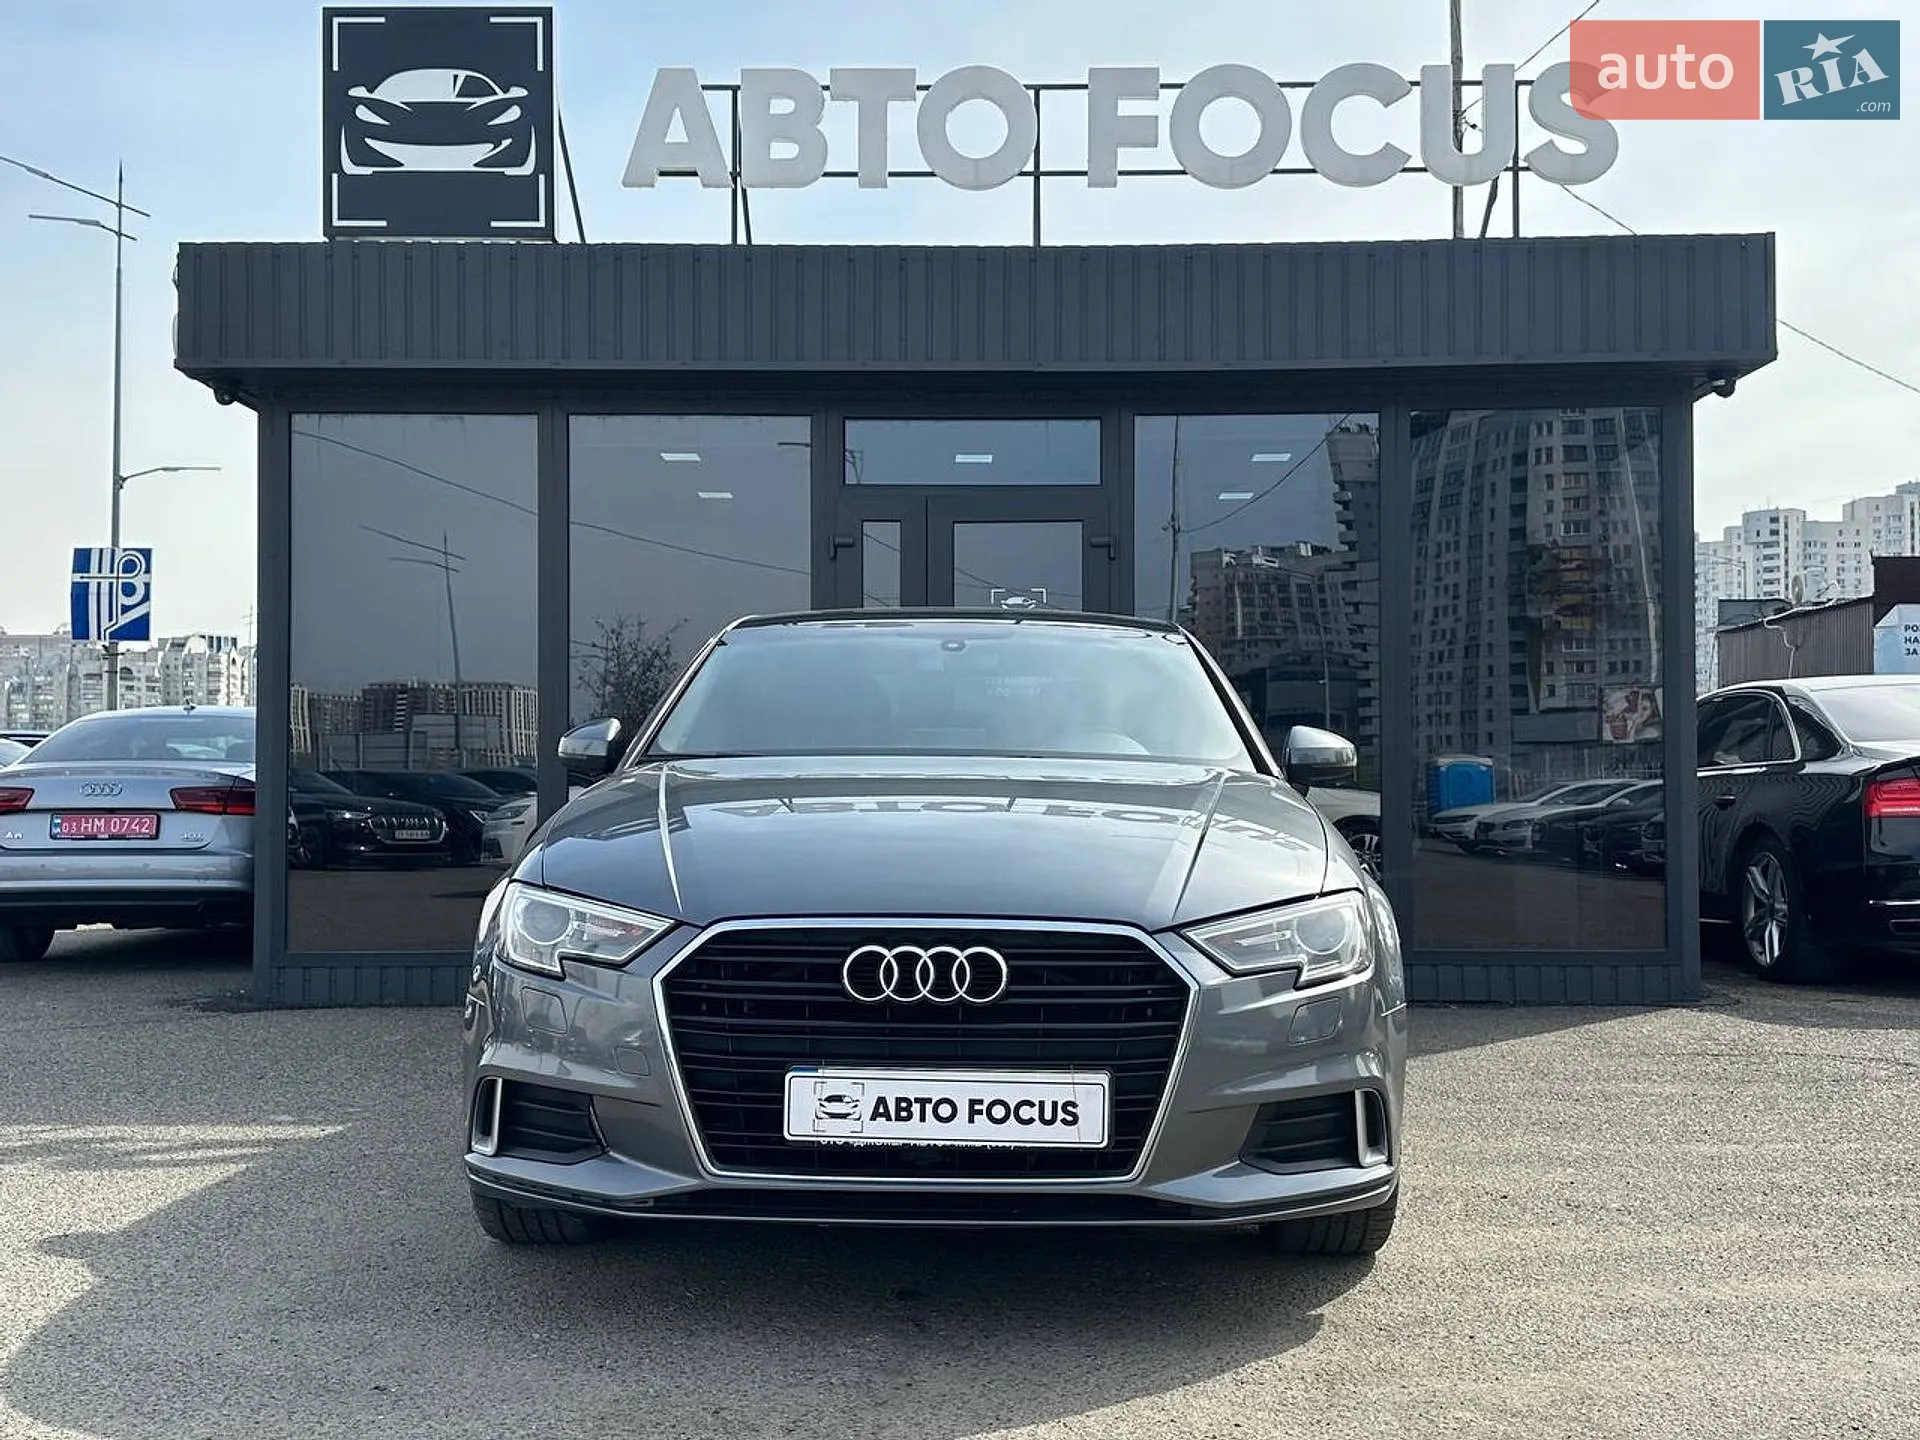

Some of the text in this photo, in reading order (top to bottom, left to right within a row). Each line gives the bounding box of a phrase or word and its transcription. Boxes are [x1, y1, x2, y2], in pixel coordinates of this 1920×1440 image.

[622, 63, 1620, 192] АВТО FOCUS
[1904, 624, 1920, 632] РО
[110, 818, 150, 833] 0742
[869, 1096, 1080, 1127] АВТО FOCUS
